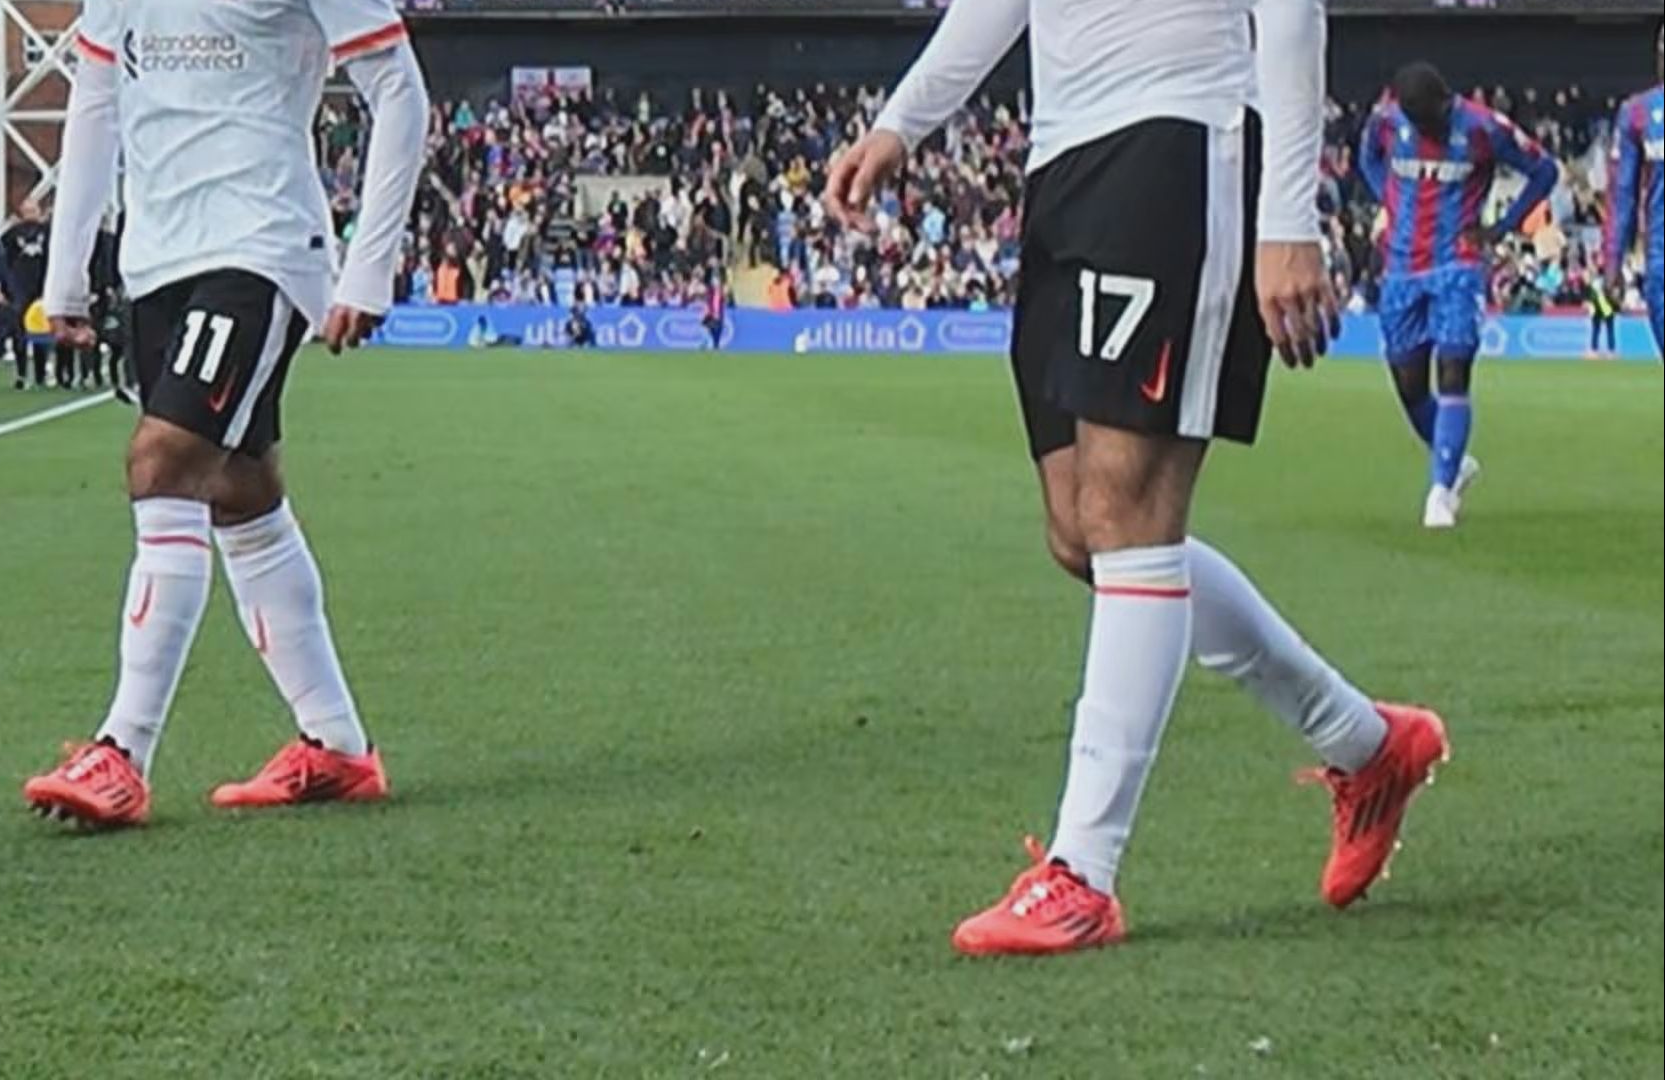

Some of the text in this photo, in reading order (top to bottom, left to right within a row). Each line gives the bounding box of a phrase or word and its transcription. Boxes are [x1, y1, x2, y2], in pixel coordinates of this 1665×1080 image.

[141, 33, 236, 52] standard
[173, 309, 234, 384] 11
[1079, 269, 1156, 361] 17
